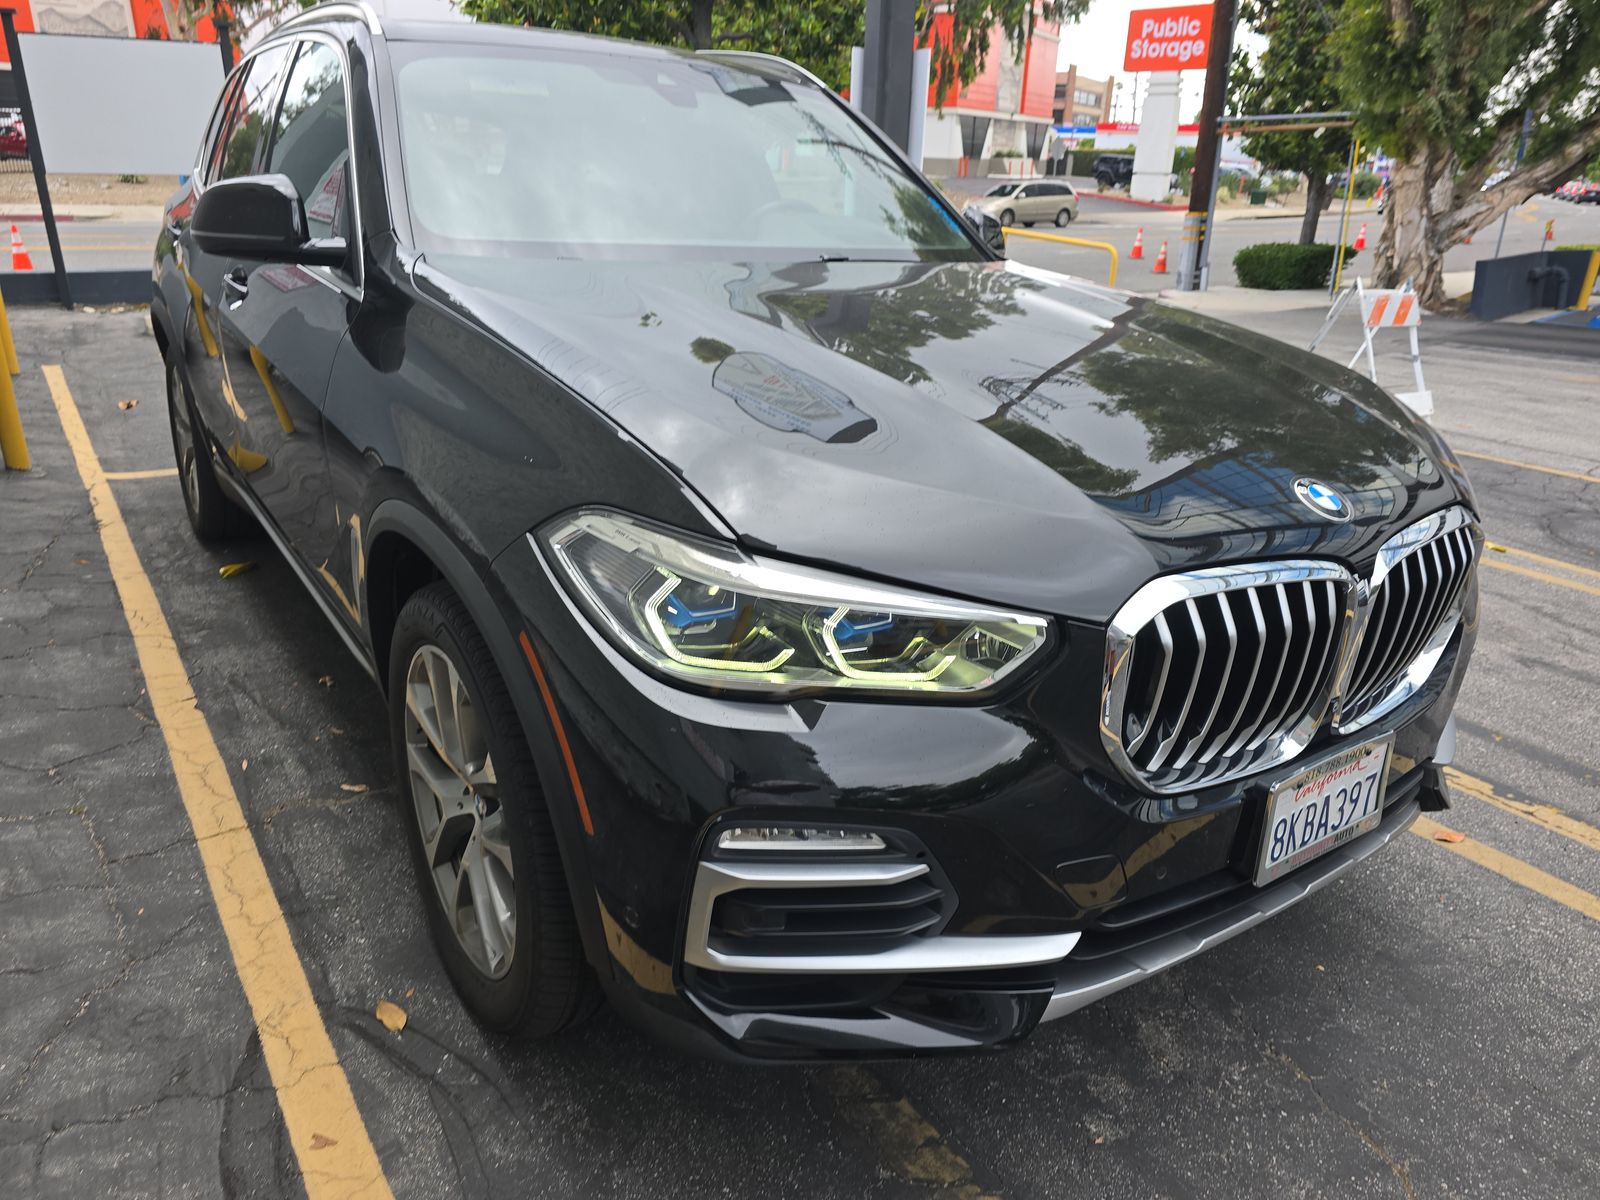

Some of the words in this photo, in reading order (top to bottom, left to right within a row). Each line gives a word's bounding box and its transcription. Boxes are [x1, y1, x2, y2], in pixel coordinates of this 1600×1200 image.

[1142, 17, 1201, 38] Public
[1131, 38, 1205, 62] Storage
[1294, 760, 1369, 802] California
[1270, 772, 1378, 862] 8KBA397
[1333, 826, 1354, 843] AUTO
